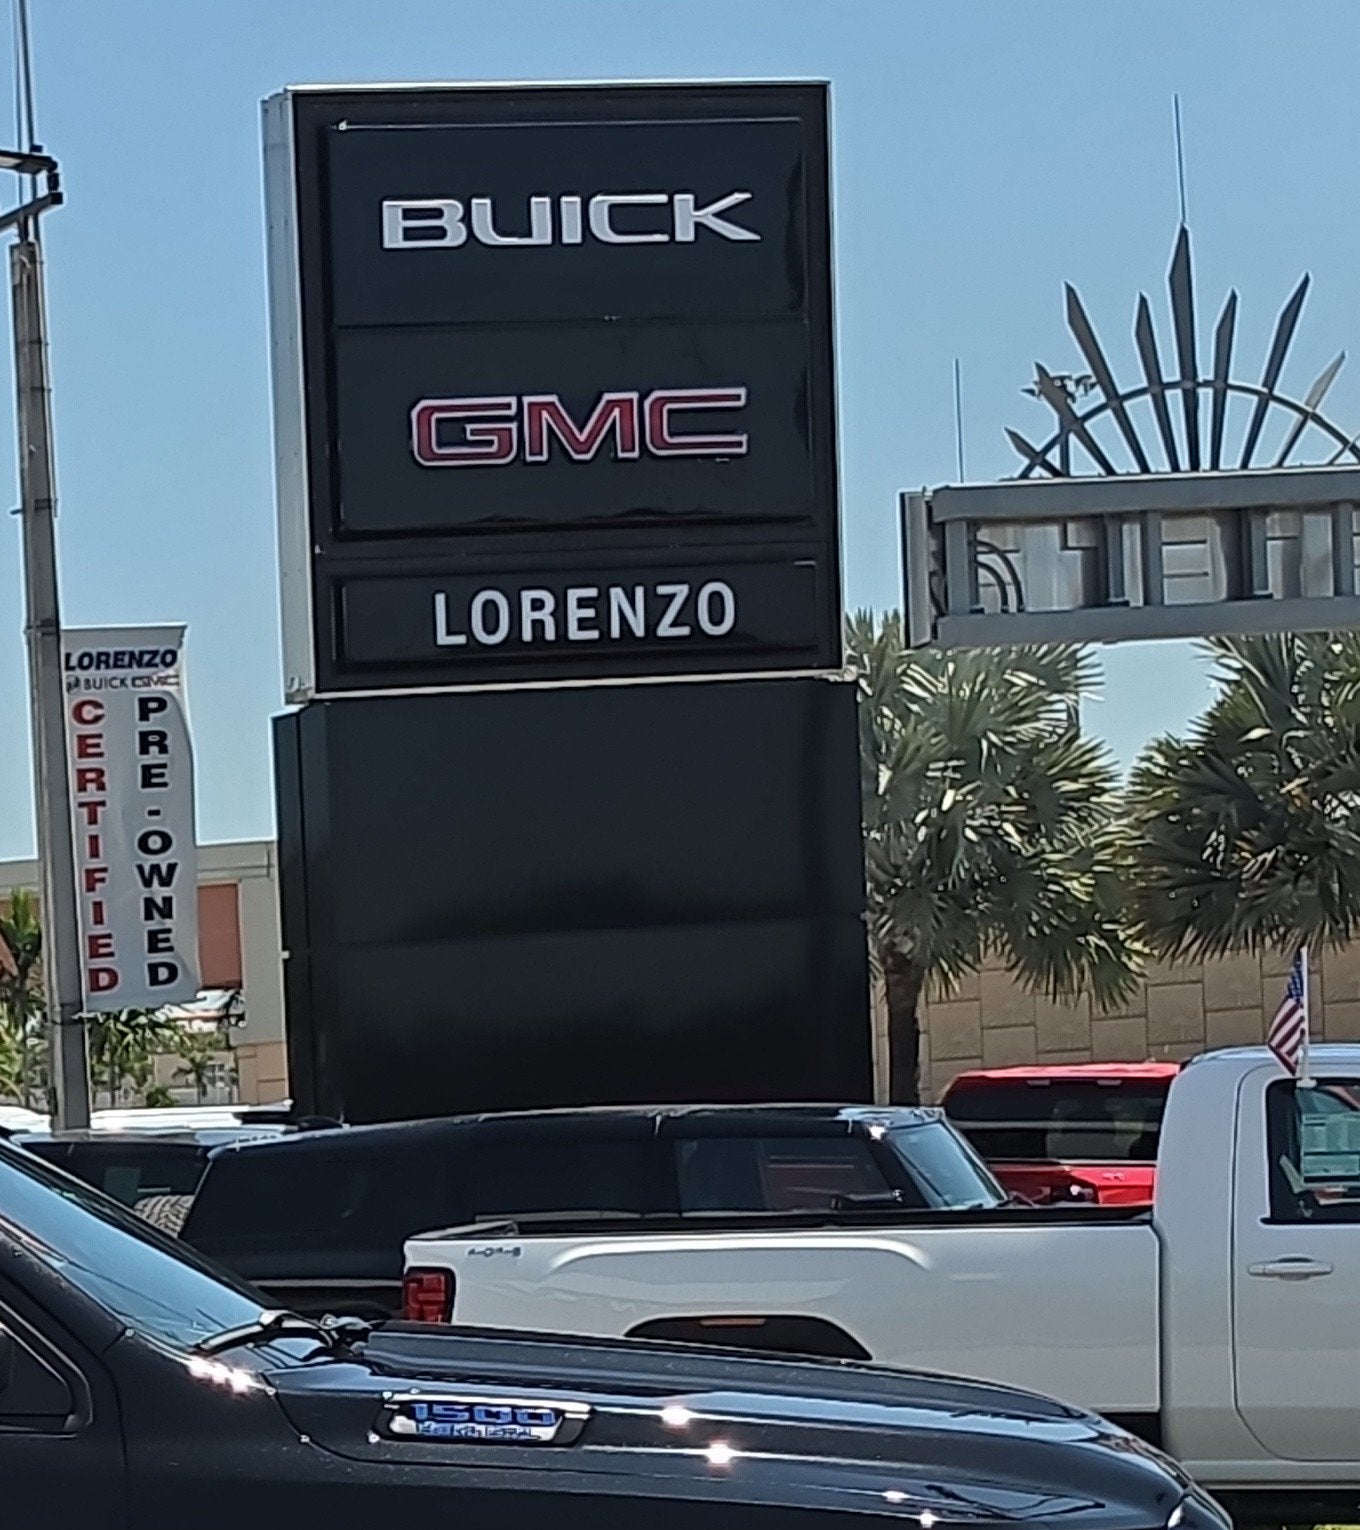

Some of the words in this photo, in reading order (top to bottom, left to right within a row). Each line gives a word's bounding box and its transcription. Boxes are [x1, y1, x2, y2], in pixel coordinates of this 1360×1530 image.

[383, 193, 761, 249] BUICK
[411, 387, 748, 467] GMC
[434, 581, 735, 646] LORENZO
[65, 649, 178, 671] LORENZO
[83, 676, 129, 691] BUICK
[72, 699, 119, 993] CERTIFIED
[135, 696, 179, 988] PRE-OWNED
[411, 1403, 557, 1424] 1500
